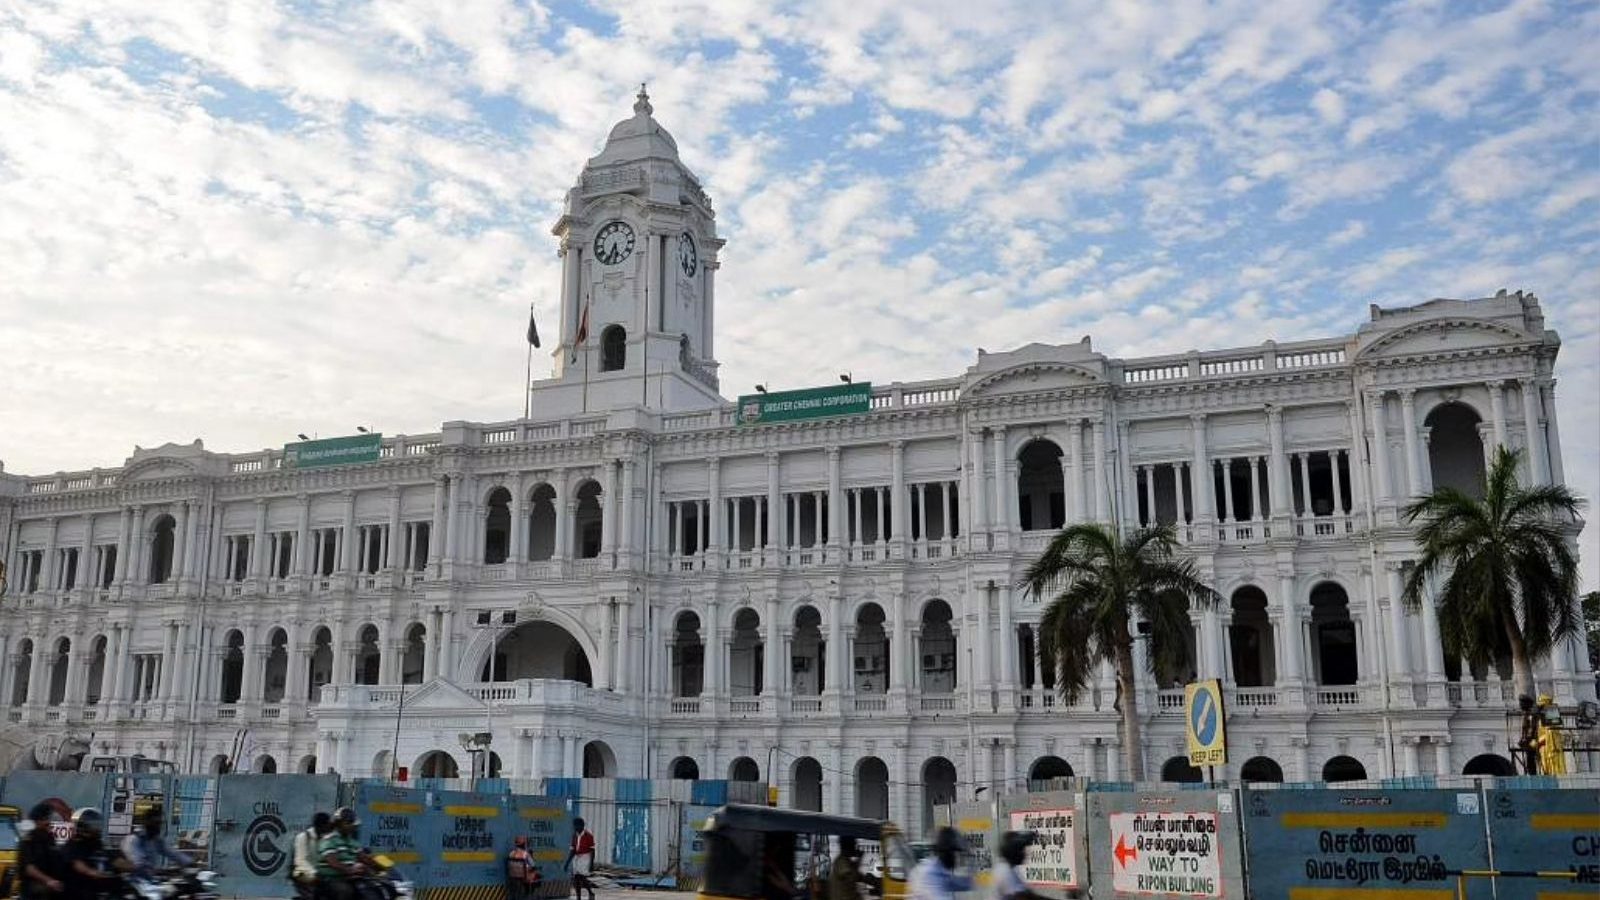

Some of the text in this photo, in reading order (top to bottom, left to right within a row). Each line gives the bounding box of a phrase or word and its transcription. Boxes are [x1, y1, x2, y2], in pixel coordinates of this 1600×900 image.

[764, 394, 867, 412] GREATER CHENNAI CORPORATION
[1191, 749, 1222, 763] KEEP LEFT
[1319, 827, 1417, 854] சென்னை
[1050, 850, 1062, 864] TO
[1148, 856, 1199, 873] WAY TO
[1138, 874, 1214, 894] RIPON BUILDING
